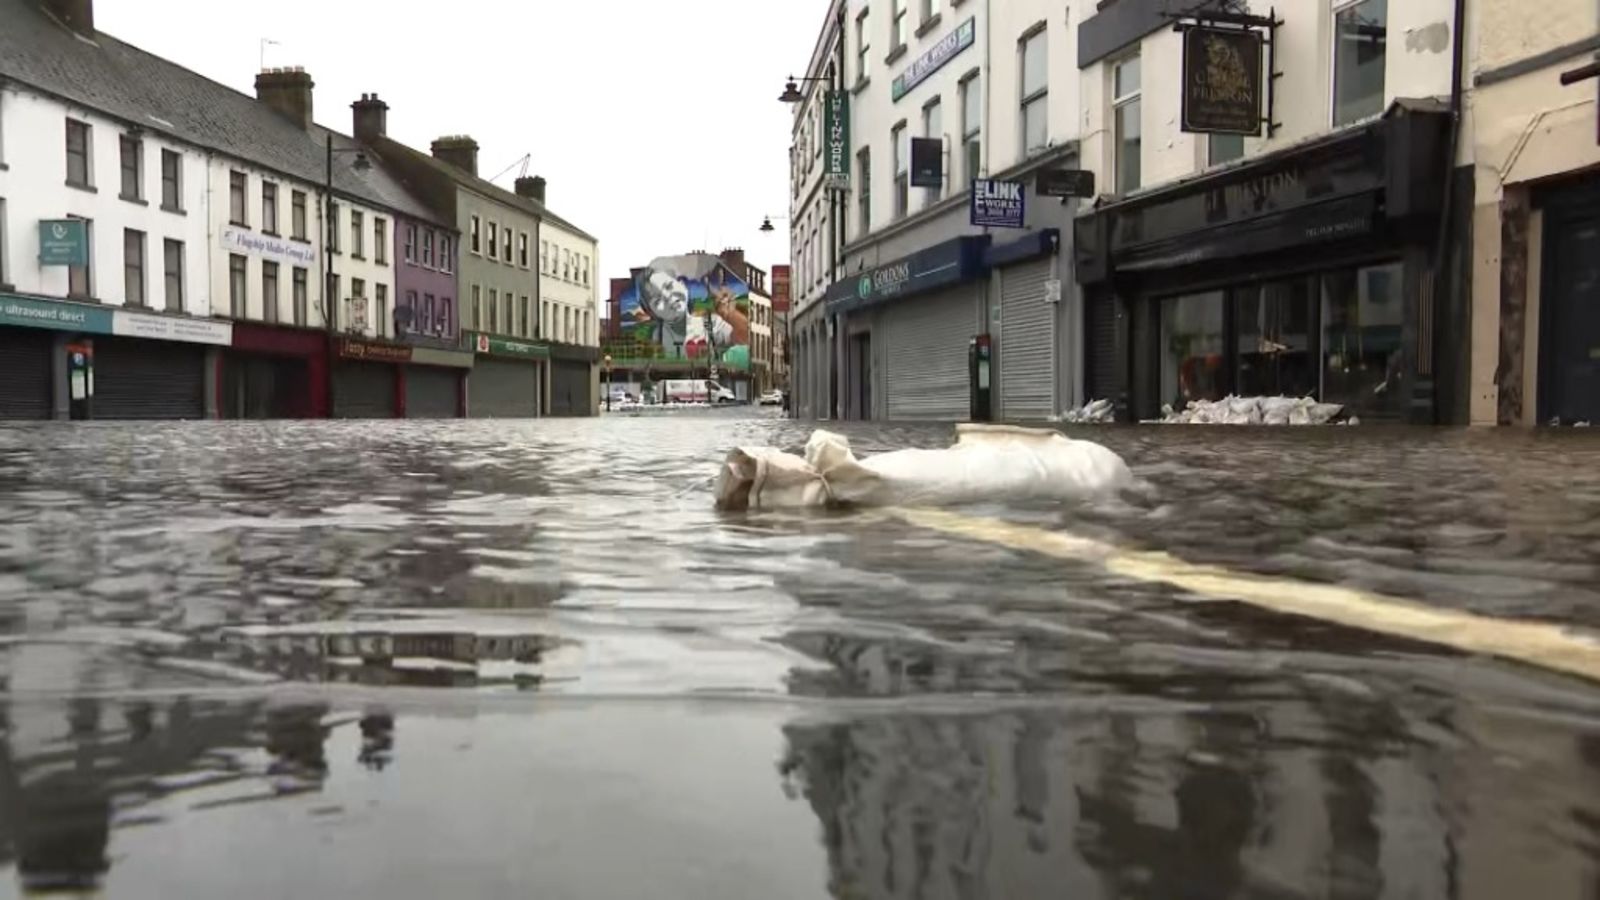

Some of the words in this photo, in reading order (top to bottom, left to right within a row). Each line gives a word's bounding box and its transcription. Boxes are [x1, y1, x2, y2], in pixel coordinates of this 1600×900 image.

[975, 180, 985, 206] THE
[985, 180, 1022, 201] LINK
[985, 200, 1022, 209] WORKS
[5, 304, 57, 319] ultrasound
[59, 309, 85, 322] direct
